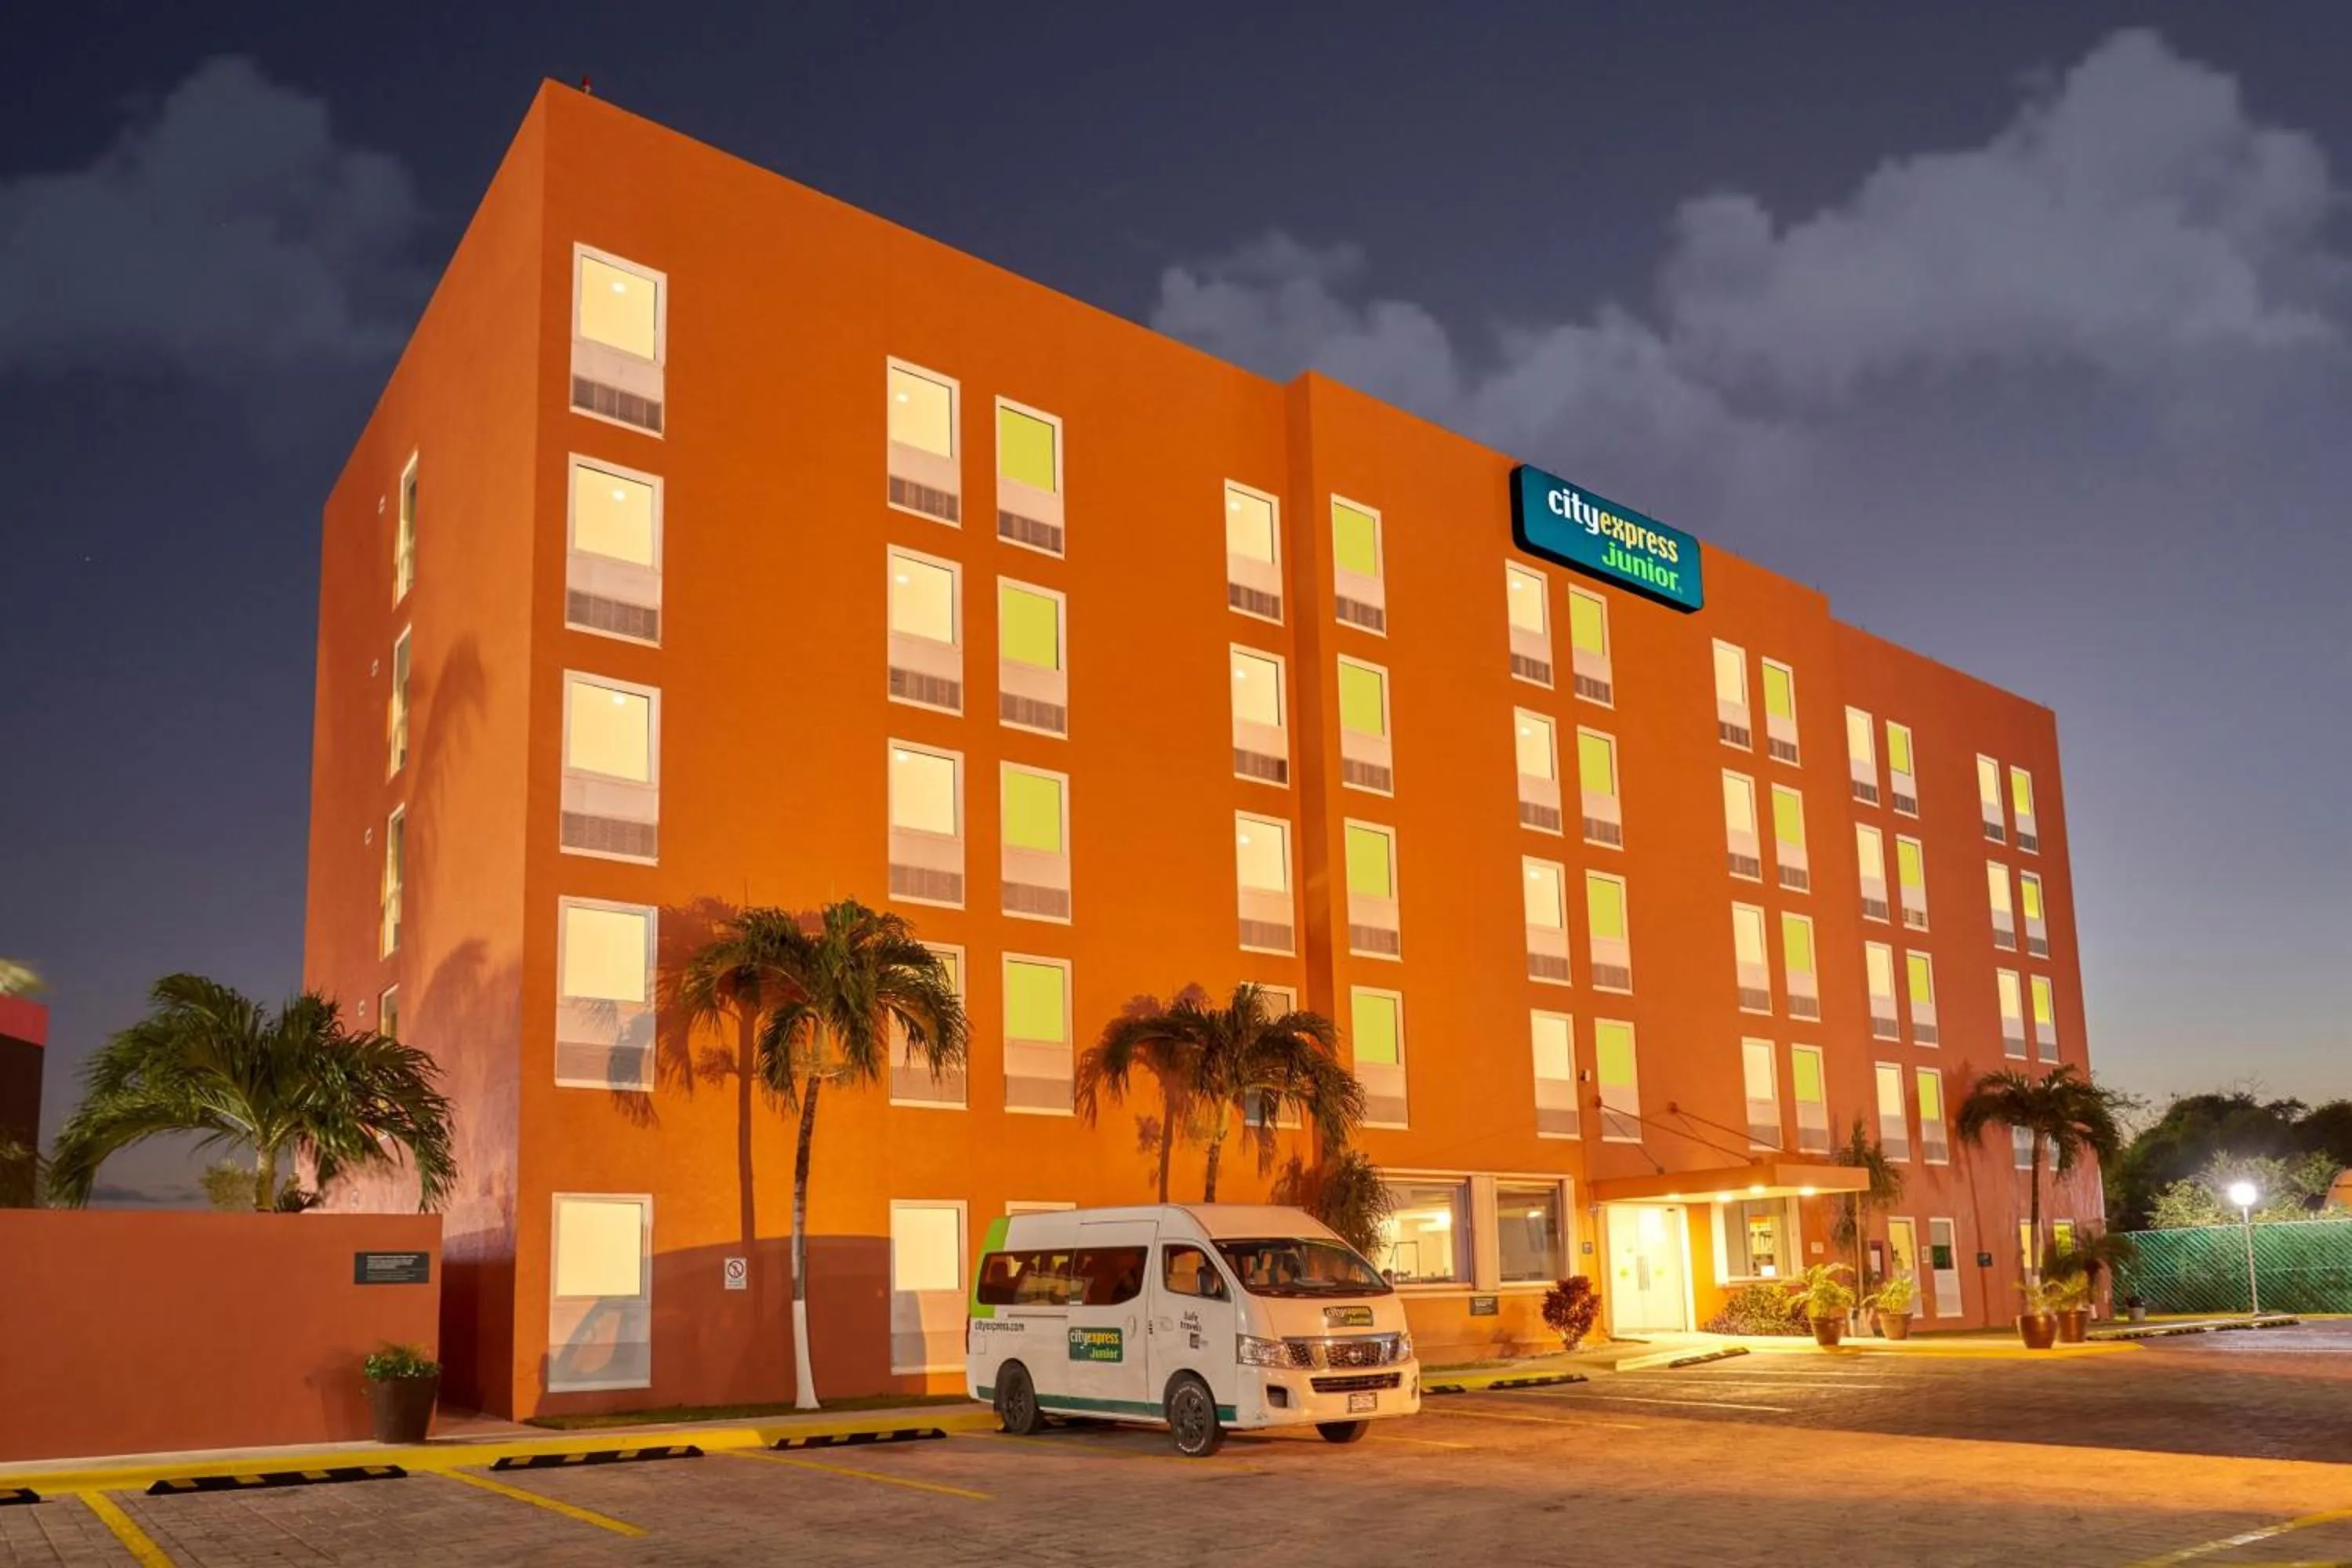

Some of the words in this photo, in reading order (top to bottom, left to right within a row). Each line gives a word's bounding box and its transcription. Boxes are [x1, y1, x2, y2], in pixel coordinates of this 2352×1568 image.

[1548, 488, 1679, 564] cityexpress
[1602, 542, 1679, 591] junior
[1070, 1329, 1119, 1346] cityexpress
